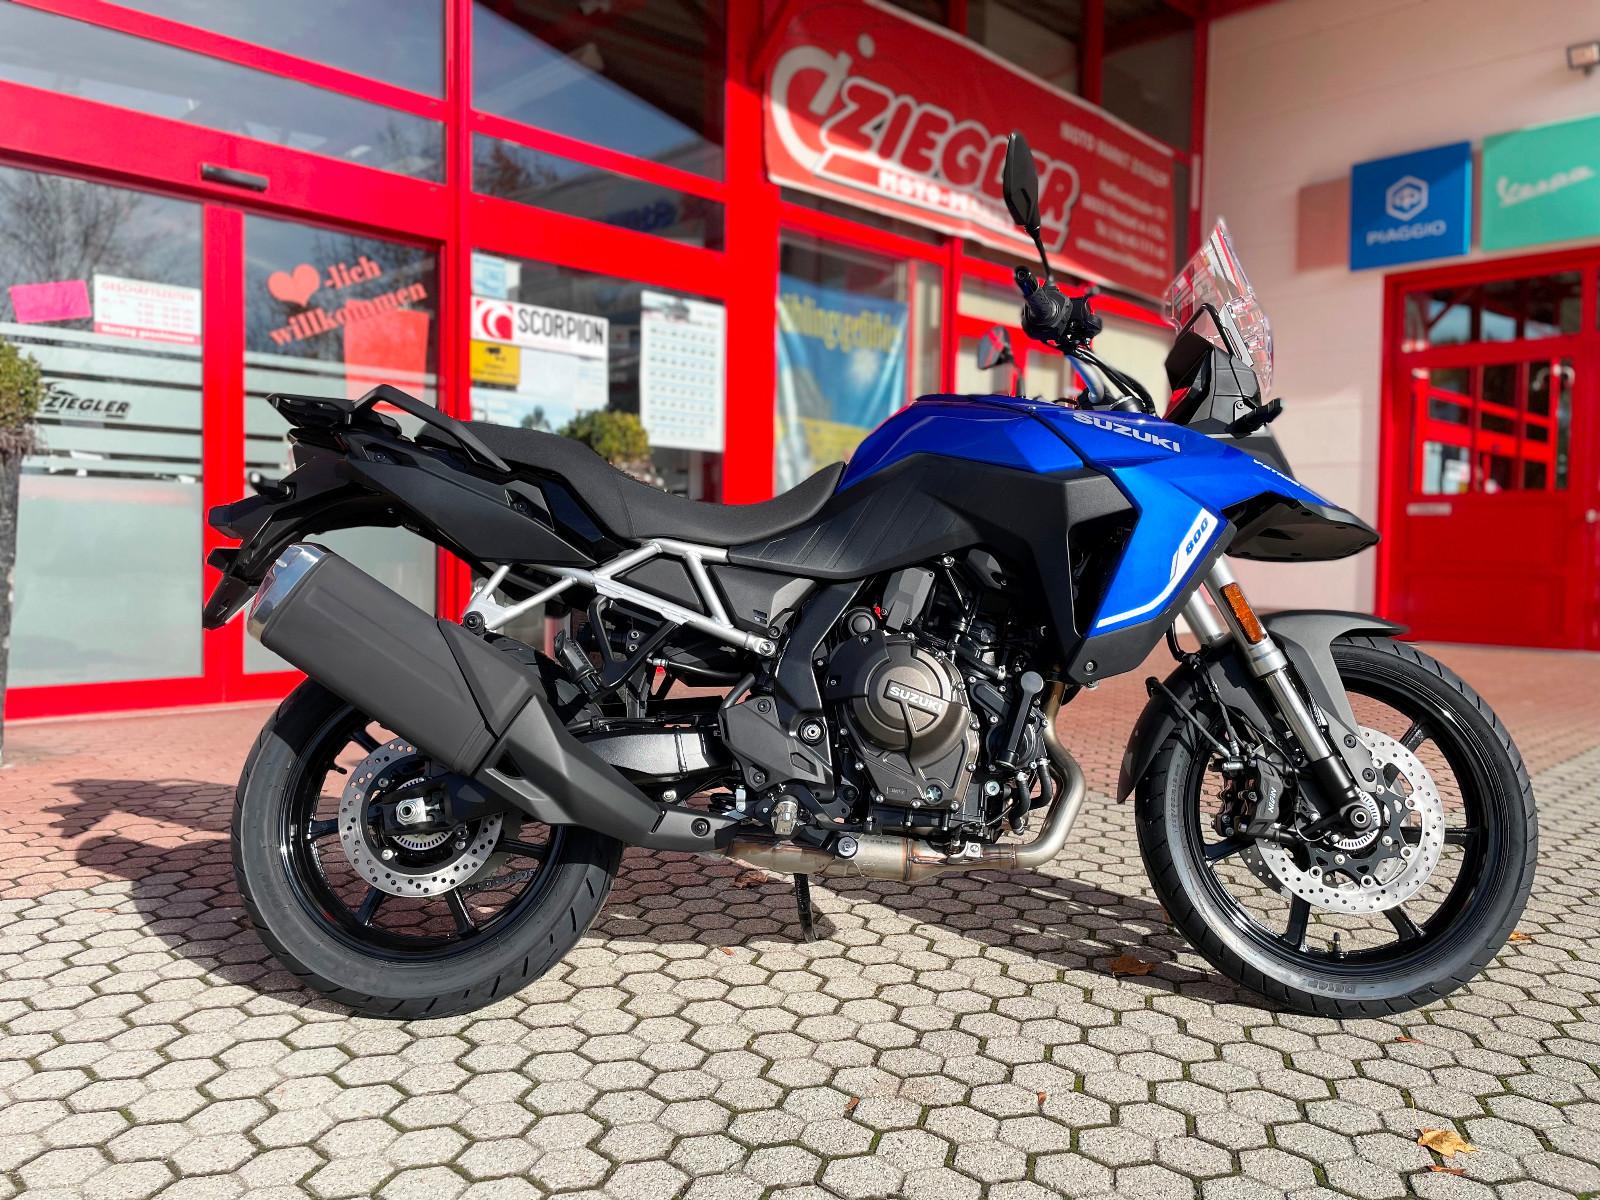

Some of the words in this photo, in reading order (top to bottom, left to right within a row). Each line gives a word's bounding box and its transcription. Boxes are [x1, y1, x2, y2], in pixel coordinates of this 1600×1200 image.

[1496, 165, 1594, 208] Vespa
[1366, 219, 1447, 246] PIAGGIO
[324, 255, 383, 290] -lich
[269, 281, 428, 346] willkommen
[518, 308, 605, 345] SCORPION
[45, 396, 130, 414] ZIEGLER
[1072, 413, 1181, 453] SUZUKI
[1185, 516, 1209, 556] 800
[889, 684, 944, 714] SUZUKI
